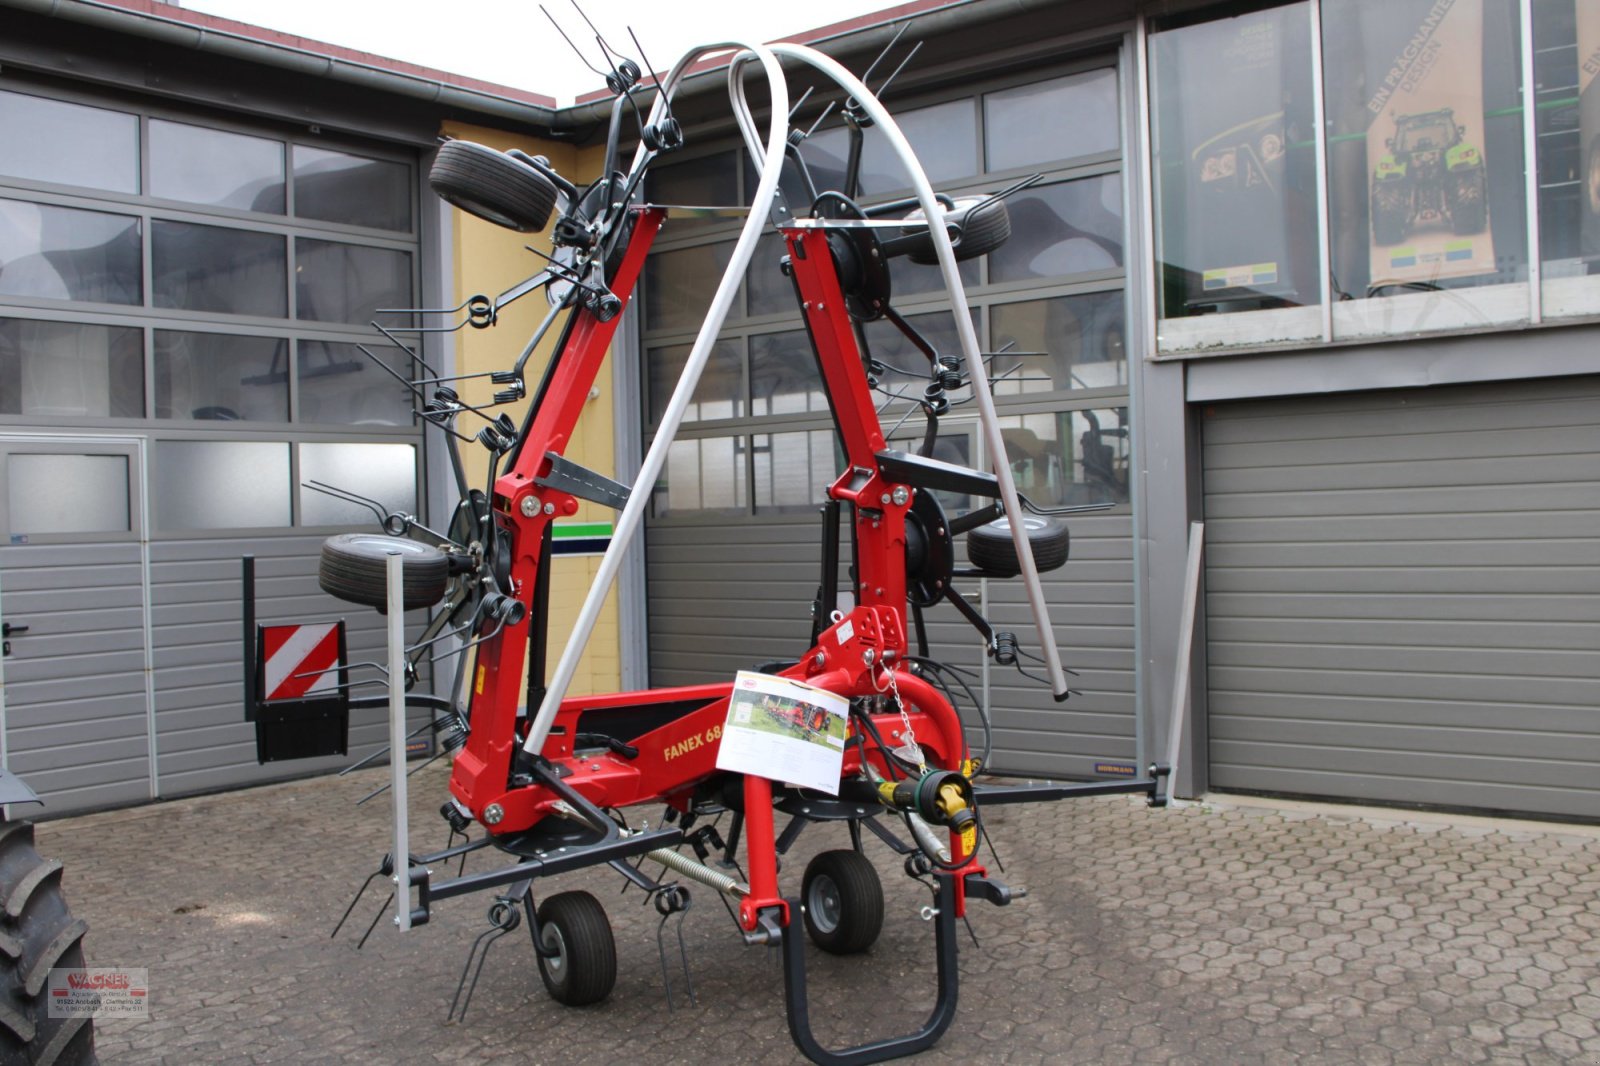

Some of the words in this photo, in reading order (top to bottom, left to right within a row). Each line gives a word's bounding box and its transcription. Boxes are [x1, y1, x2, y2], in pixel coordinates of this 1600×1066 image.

[1367, 86, 1391, 113] EIN
[663, 733, 704, 762] FANEX
[705, 723, 724, 743] 68
